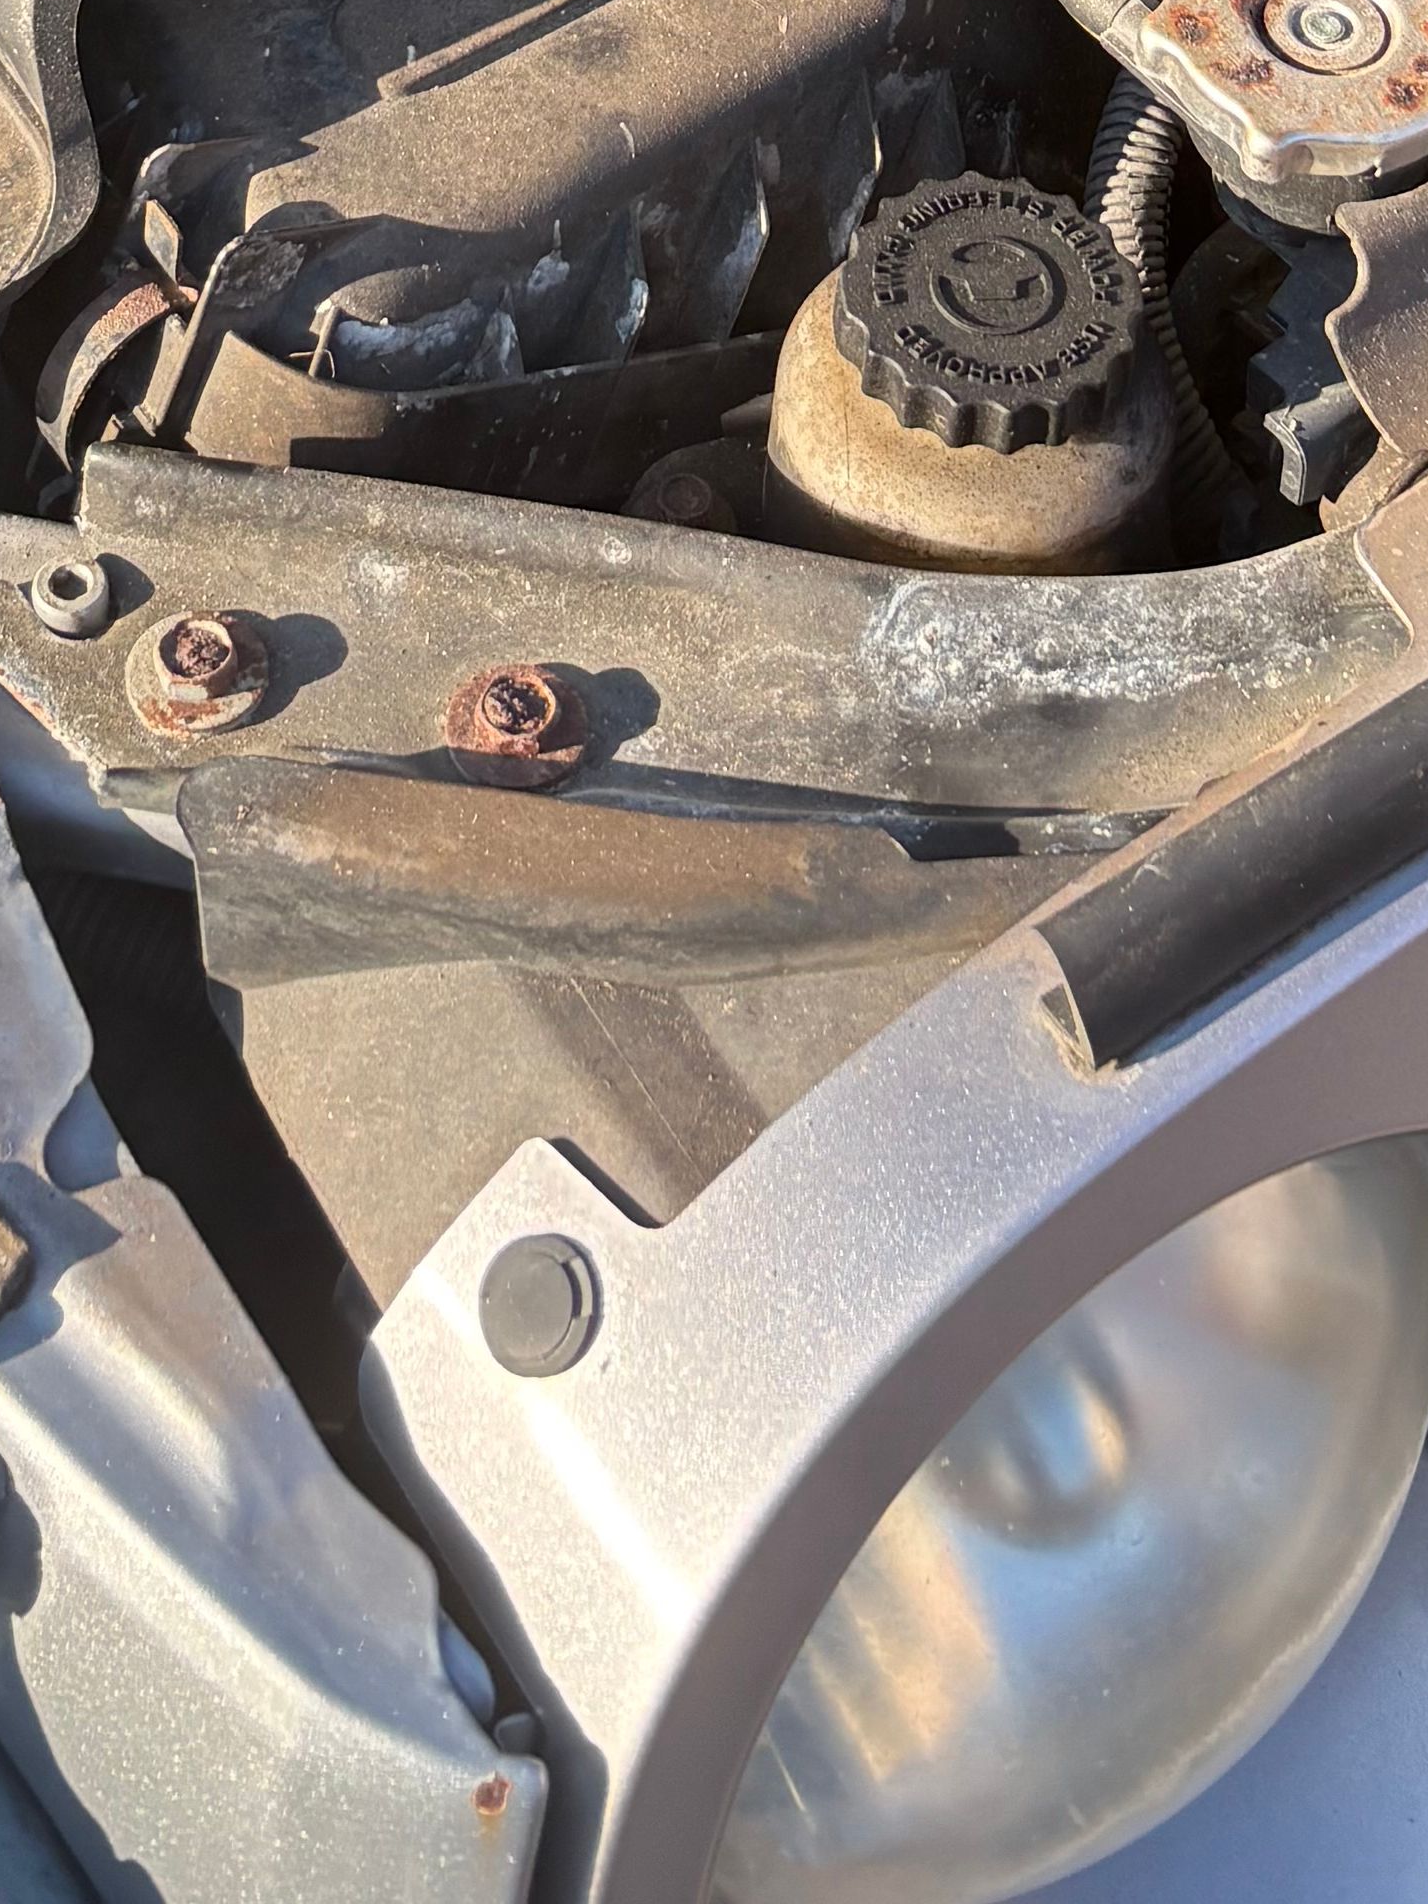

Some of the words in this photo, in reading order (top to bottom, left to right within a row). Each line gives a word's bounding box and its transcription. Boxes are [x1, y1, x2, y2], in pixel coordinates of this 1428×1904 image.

[897, 190, 1047, 234] STEERING
[1051, 216, 1117, 307] POWER
[893, 325, 1048, 386] APPROVED
[1057, 323, 1107, 368] USE
